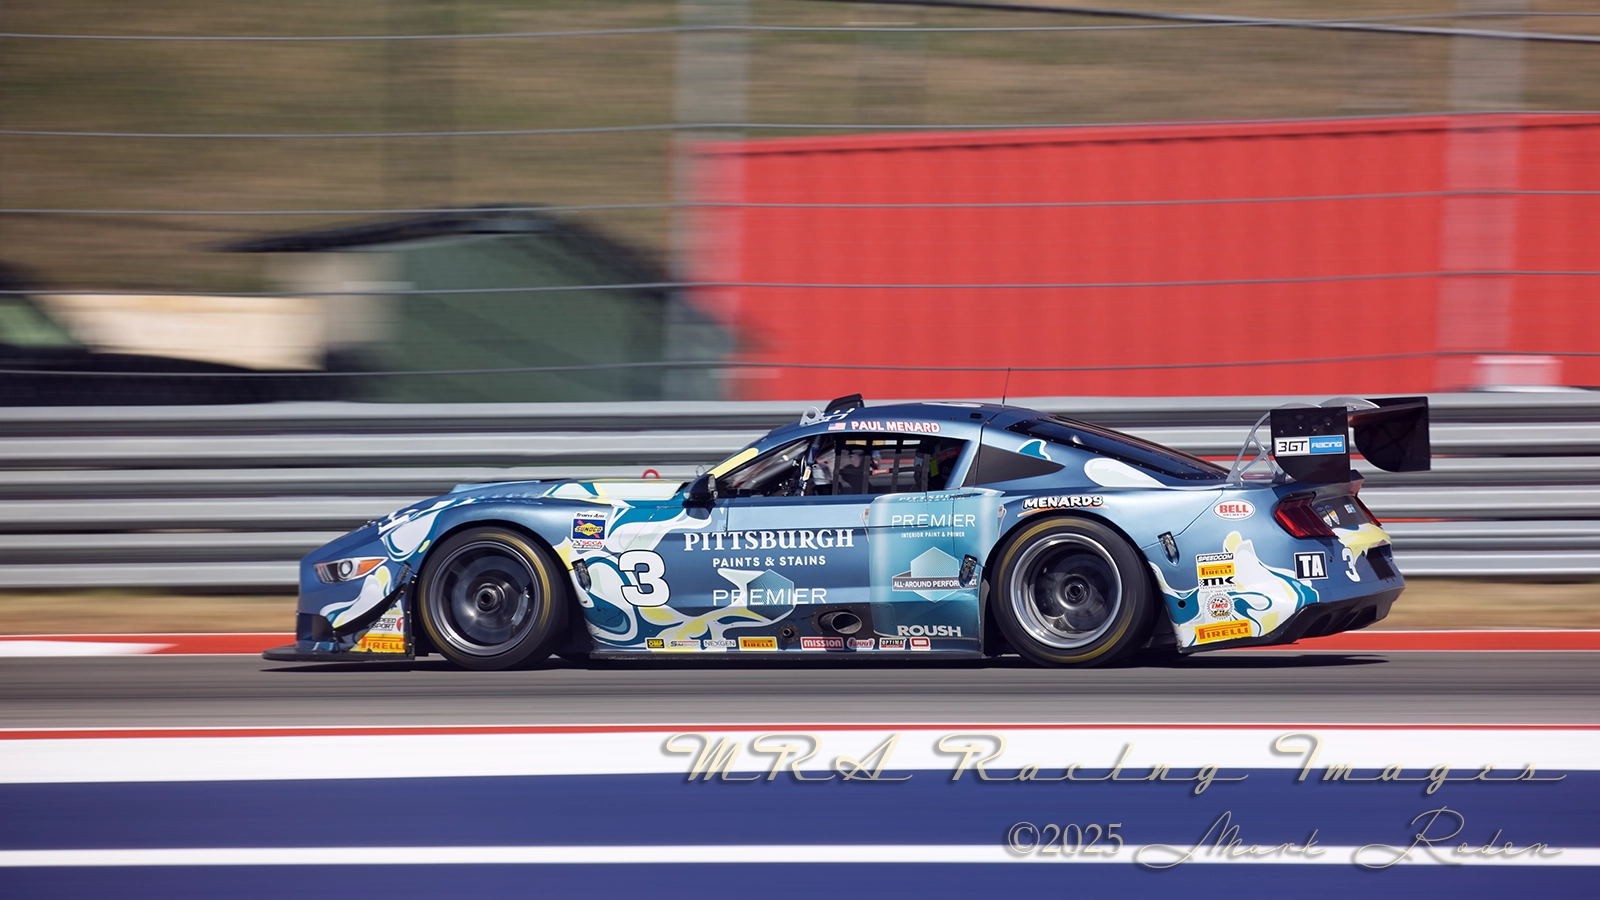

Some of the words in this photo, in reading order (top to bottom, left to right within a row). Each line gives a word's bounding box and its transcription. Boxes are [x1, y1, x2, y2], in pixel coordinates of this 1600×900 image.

[851, 421, 884, 431] PAUL
[886, 422, 941, 433] MENARD
[1278, 441, 1307, 452] 3GT
[1023, 496, 1103, 509] MENARDS
[1219, 505, 1249, 513] BELL
[892, 514, 976, 528] PREMIER
[684, 529, 854, 551] PITTSBURGH
[713, 557, 760, 567] PAINTS
[765, 556, 774, 566] &
[779, 555, 826, 565] STAINS
[1199, 554, 1232, 562] SPEEDCOM
[1201, 565, 1231, 575] PIRELLI
[1299, 555, 1324, 577] TA
[1342, 547, 1361, 582] 3
[618, 549, 671, 607] 3
[713, 588, 827, 606] PREMIER
[897, 625, 962, 637] ROUSH
[1198, 623, 1248, 640] PIRELLI
[743, 640, 773, 648] PIRELLI
